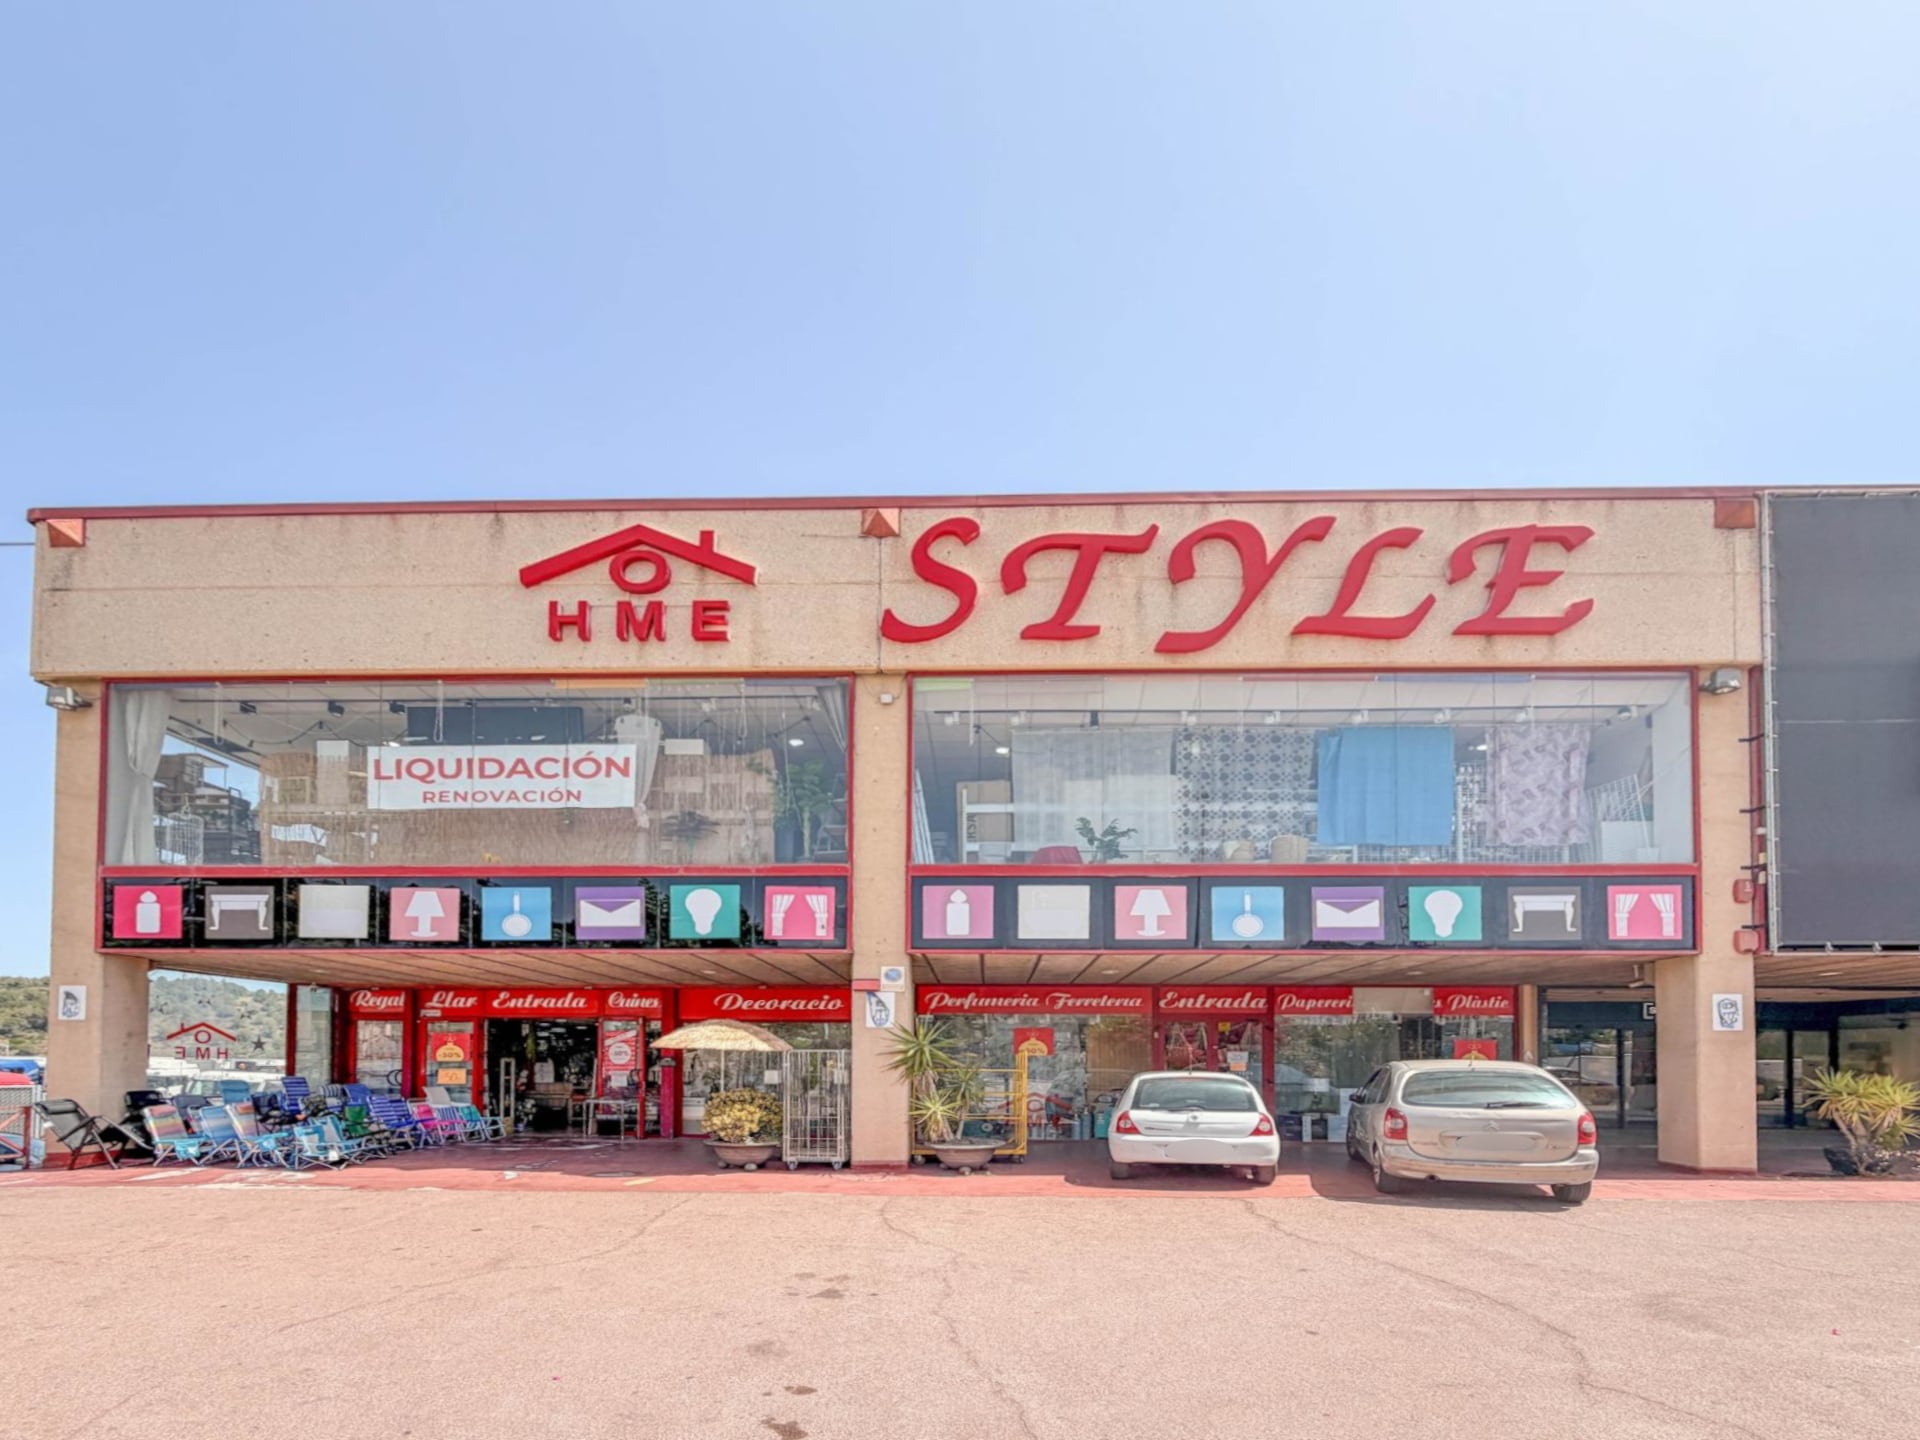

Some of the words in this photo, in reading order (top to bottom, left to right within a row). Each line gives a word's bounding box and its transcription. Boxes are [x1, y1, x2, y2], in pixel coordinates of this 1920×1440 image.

[881, 515, 1596, 653] STYLE
[373, 752, 631, 784] LIQUIDACIÓN
[422, 788, 582, 804] RENOVACIÓN
[351, 990, 405, 1009] Regal
[425, 991, 478, 1008] Llar
[492, 991, 588, 1009] Entrada
[608, 991, 662, 1009] Cuines
[924, 992, 1040, 1010] Perfumeria
[1159, 991, 1268, 1009] Entrada
[1277, 992, 1353, 1011] Papereri
